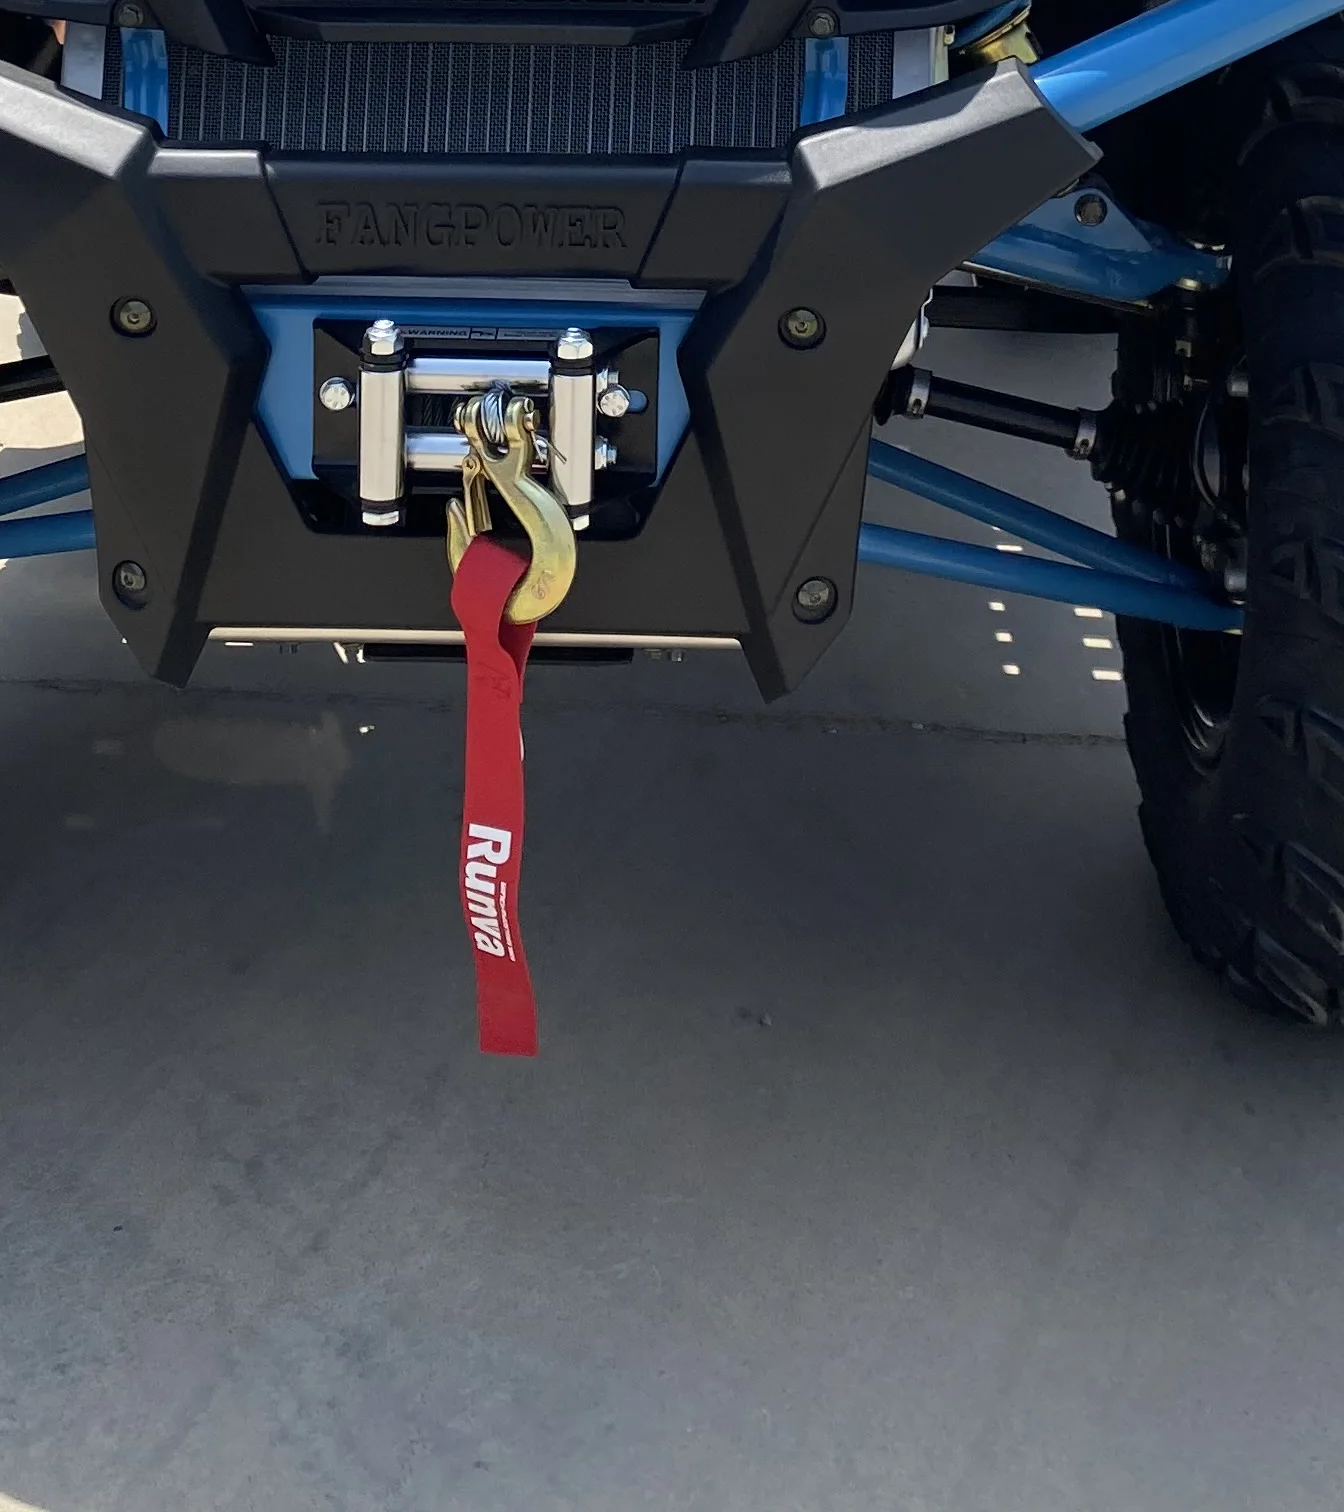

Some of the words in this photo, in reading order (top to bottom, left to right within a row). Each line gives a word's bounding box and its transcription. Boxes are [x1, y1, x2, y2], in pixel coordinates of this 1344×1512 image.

[316, 201, 628, 250] FANGPOWER
[408, 329, 468, 337] WARNING
[465, 823, 512, 957] Runva
